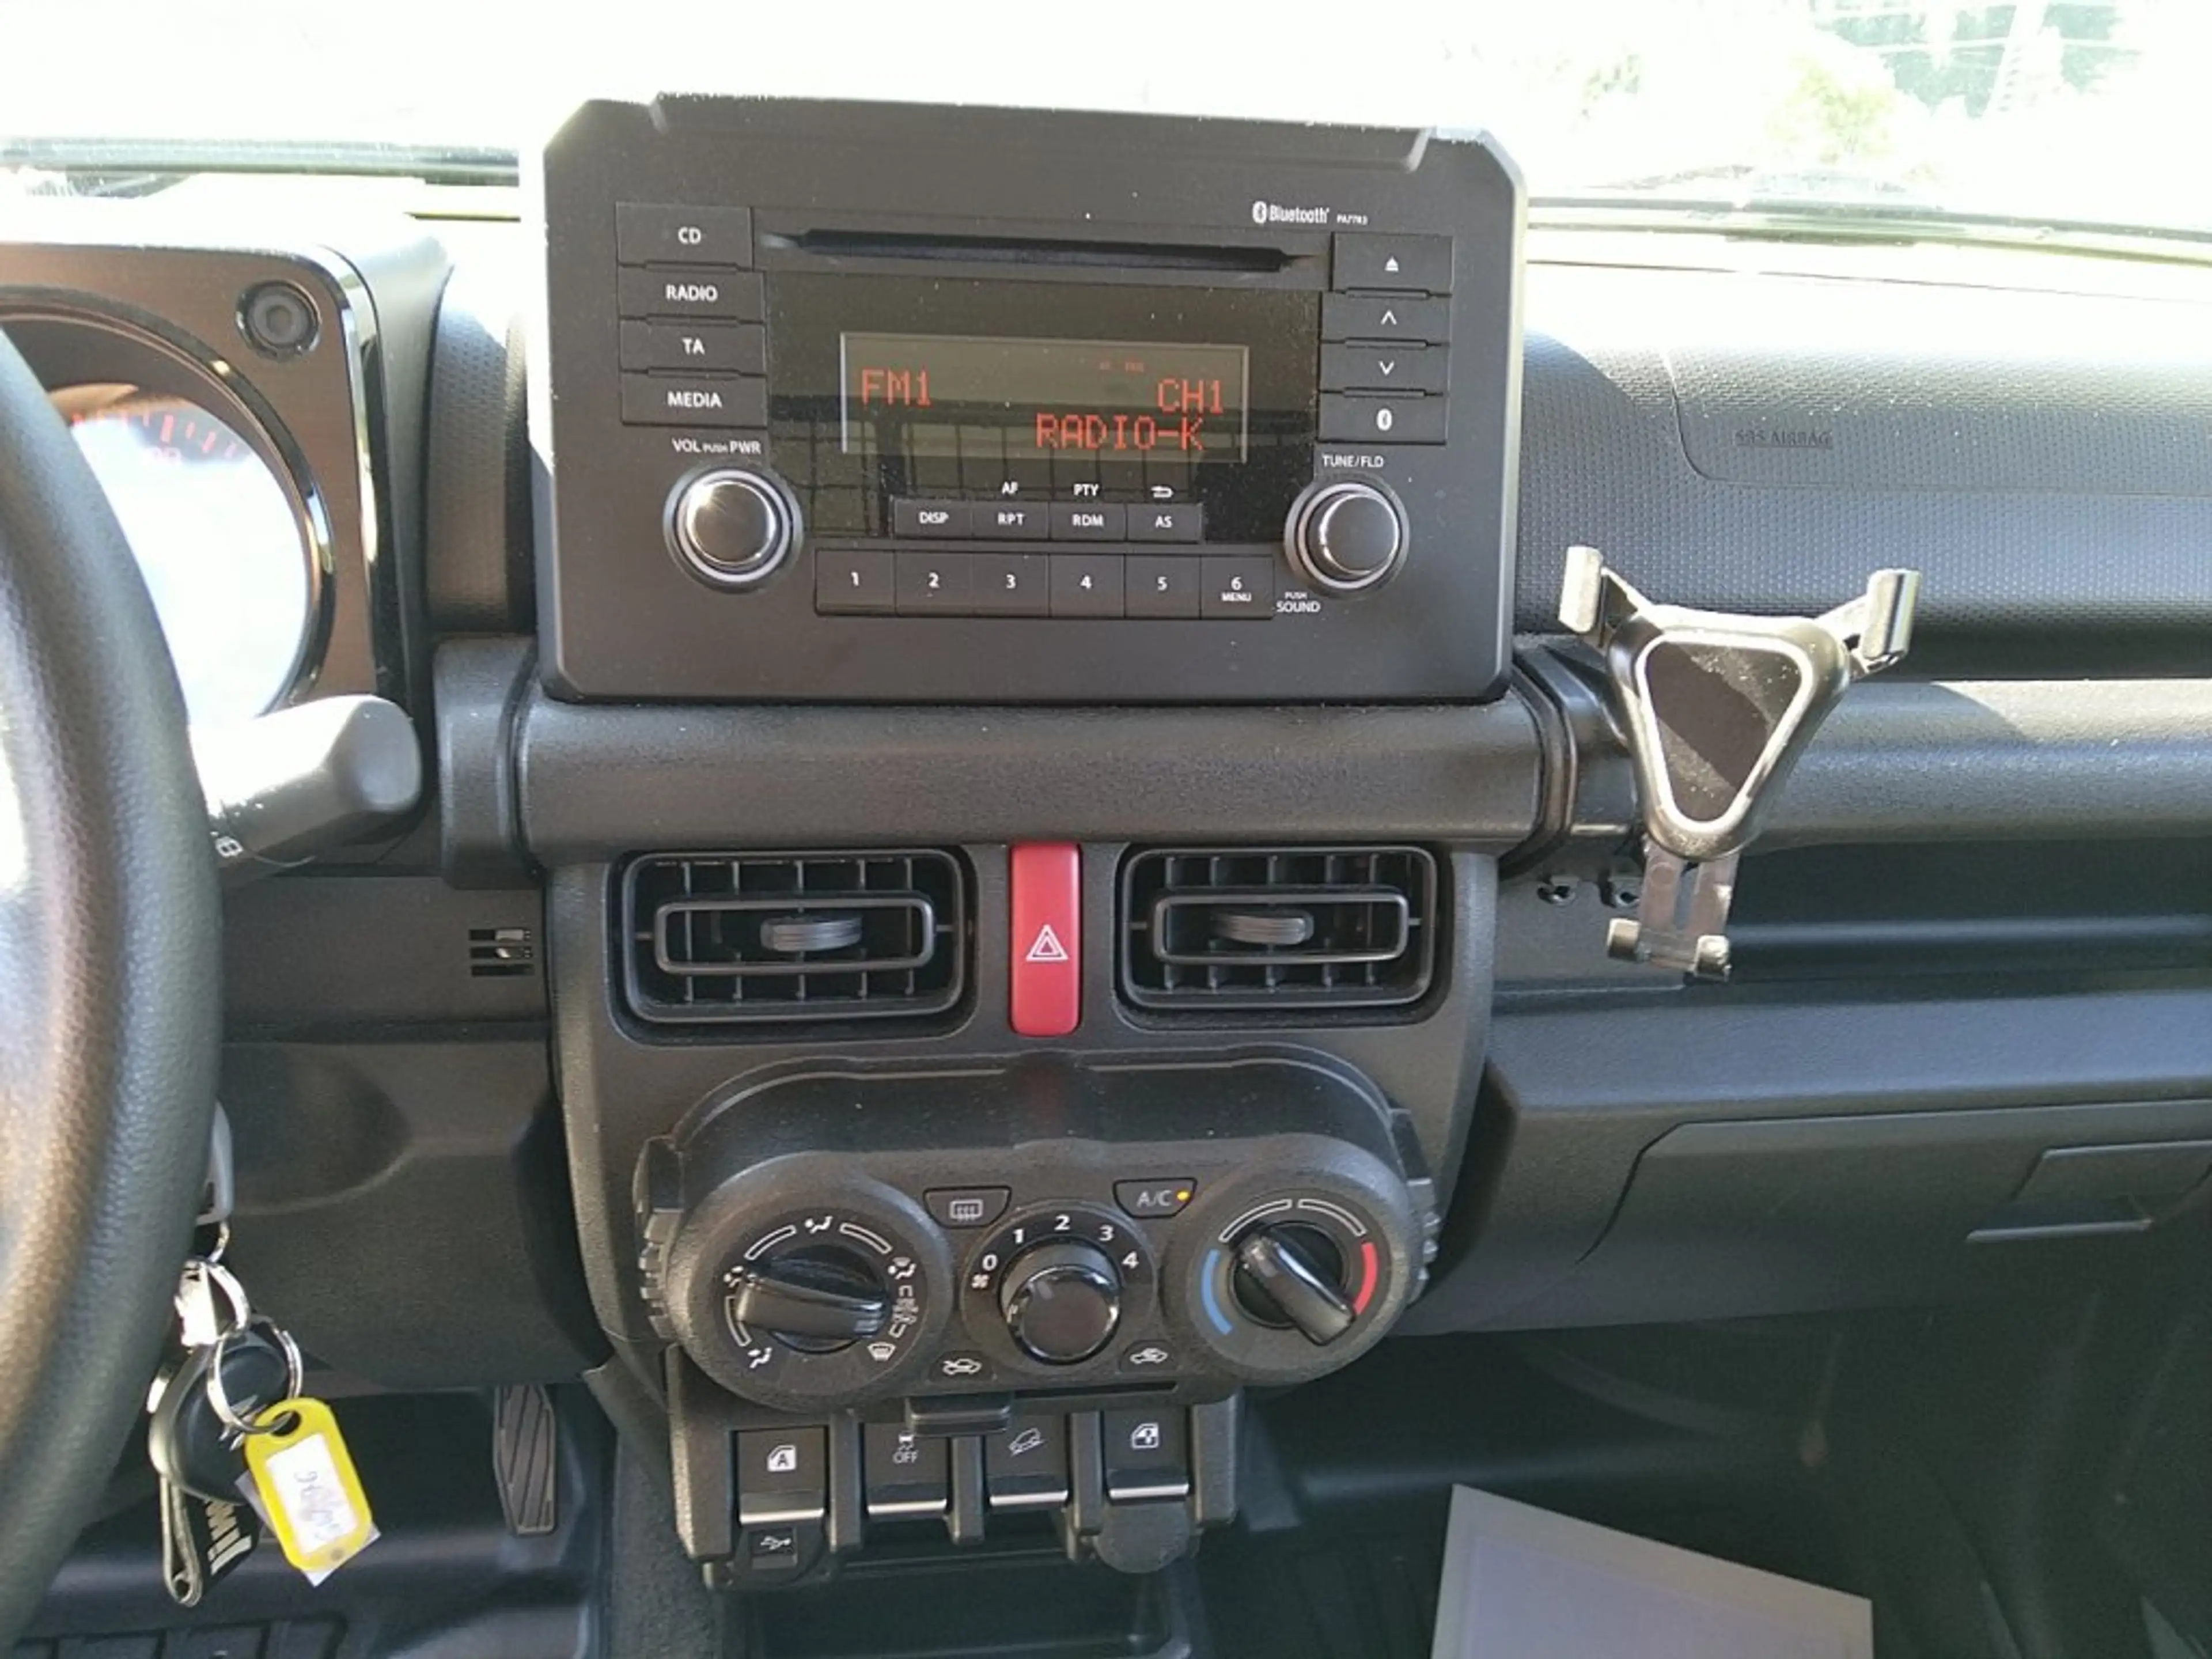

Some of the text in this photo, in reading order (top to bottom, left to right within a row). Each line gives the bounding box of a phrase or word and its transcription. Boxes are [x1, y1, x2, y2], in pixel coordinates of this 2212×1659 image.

[1269, 204, 1330, 224] Bluetooth
[678, 227, 702, 244] CD
[666, 285, 718, 302] RADIO
[683, 338, 704, 355] TA
[862, 369, 932, 406] FM1
[667, 392, 722, 408] MEDIA
[1157, 379, 1223, 413] CH1
[1036, 414, 1205, 450] RADIO-K
[672, 438, 701, 453] VOL
[730, 441, 761, 454] PWR
[1322, 454, 1384, 467] TUNE/FLD
[1001, 482, 1018, 494] AF
[1073, 484, 1100, 497] PTY
[919, 512, 949, 524] DISP
[998, 513, 1025, 525] RPT
[1072, 514, 1104, 527] RDM
[1154, 516, 1172, 528] AS
[851, 571, 859, 586] 1
[928, 572, 940, 588] 2
[1006, 574, 1016, 589] 3
[1080, 575, 1092, 589] 4
[1157, 576, 1167, 591] 5
[1230, 576, 1242, 591] 6
[1221, 592, 1252, 602] MENU
[1285, 592, 1307, 600] PUSH
[1276, 600, 1321, 613] SOUND
[1137, 1190, 1172, 1207] A/C
[1054, 1215, 1070, 1231] 2
[1012, 1229, 1024, 1244] 1
[1099, 1225, 1113, 1241] 3
[983, 1255, 998, 1271] 0
[1122, 1251, 1139, 1268] 4
[777, 1453, 789, 1467] A
[892, 1450, 919, 1464] OFF
